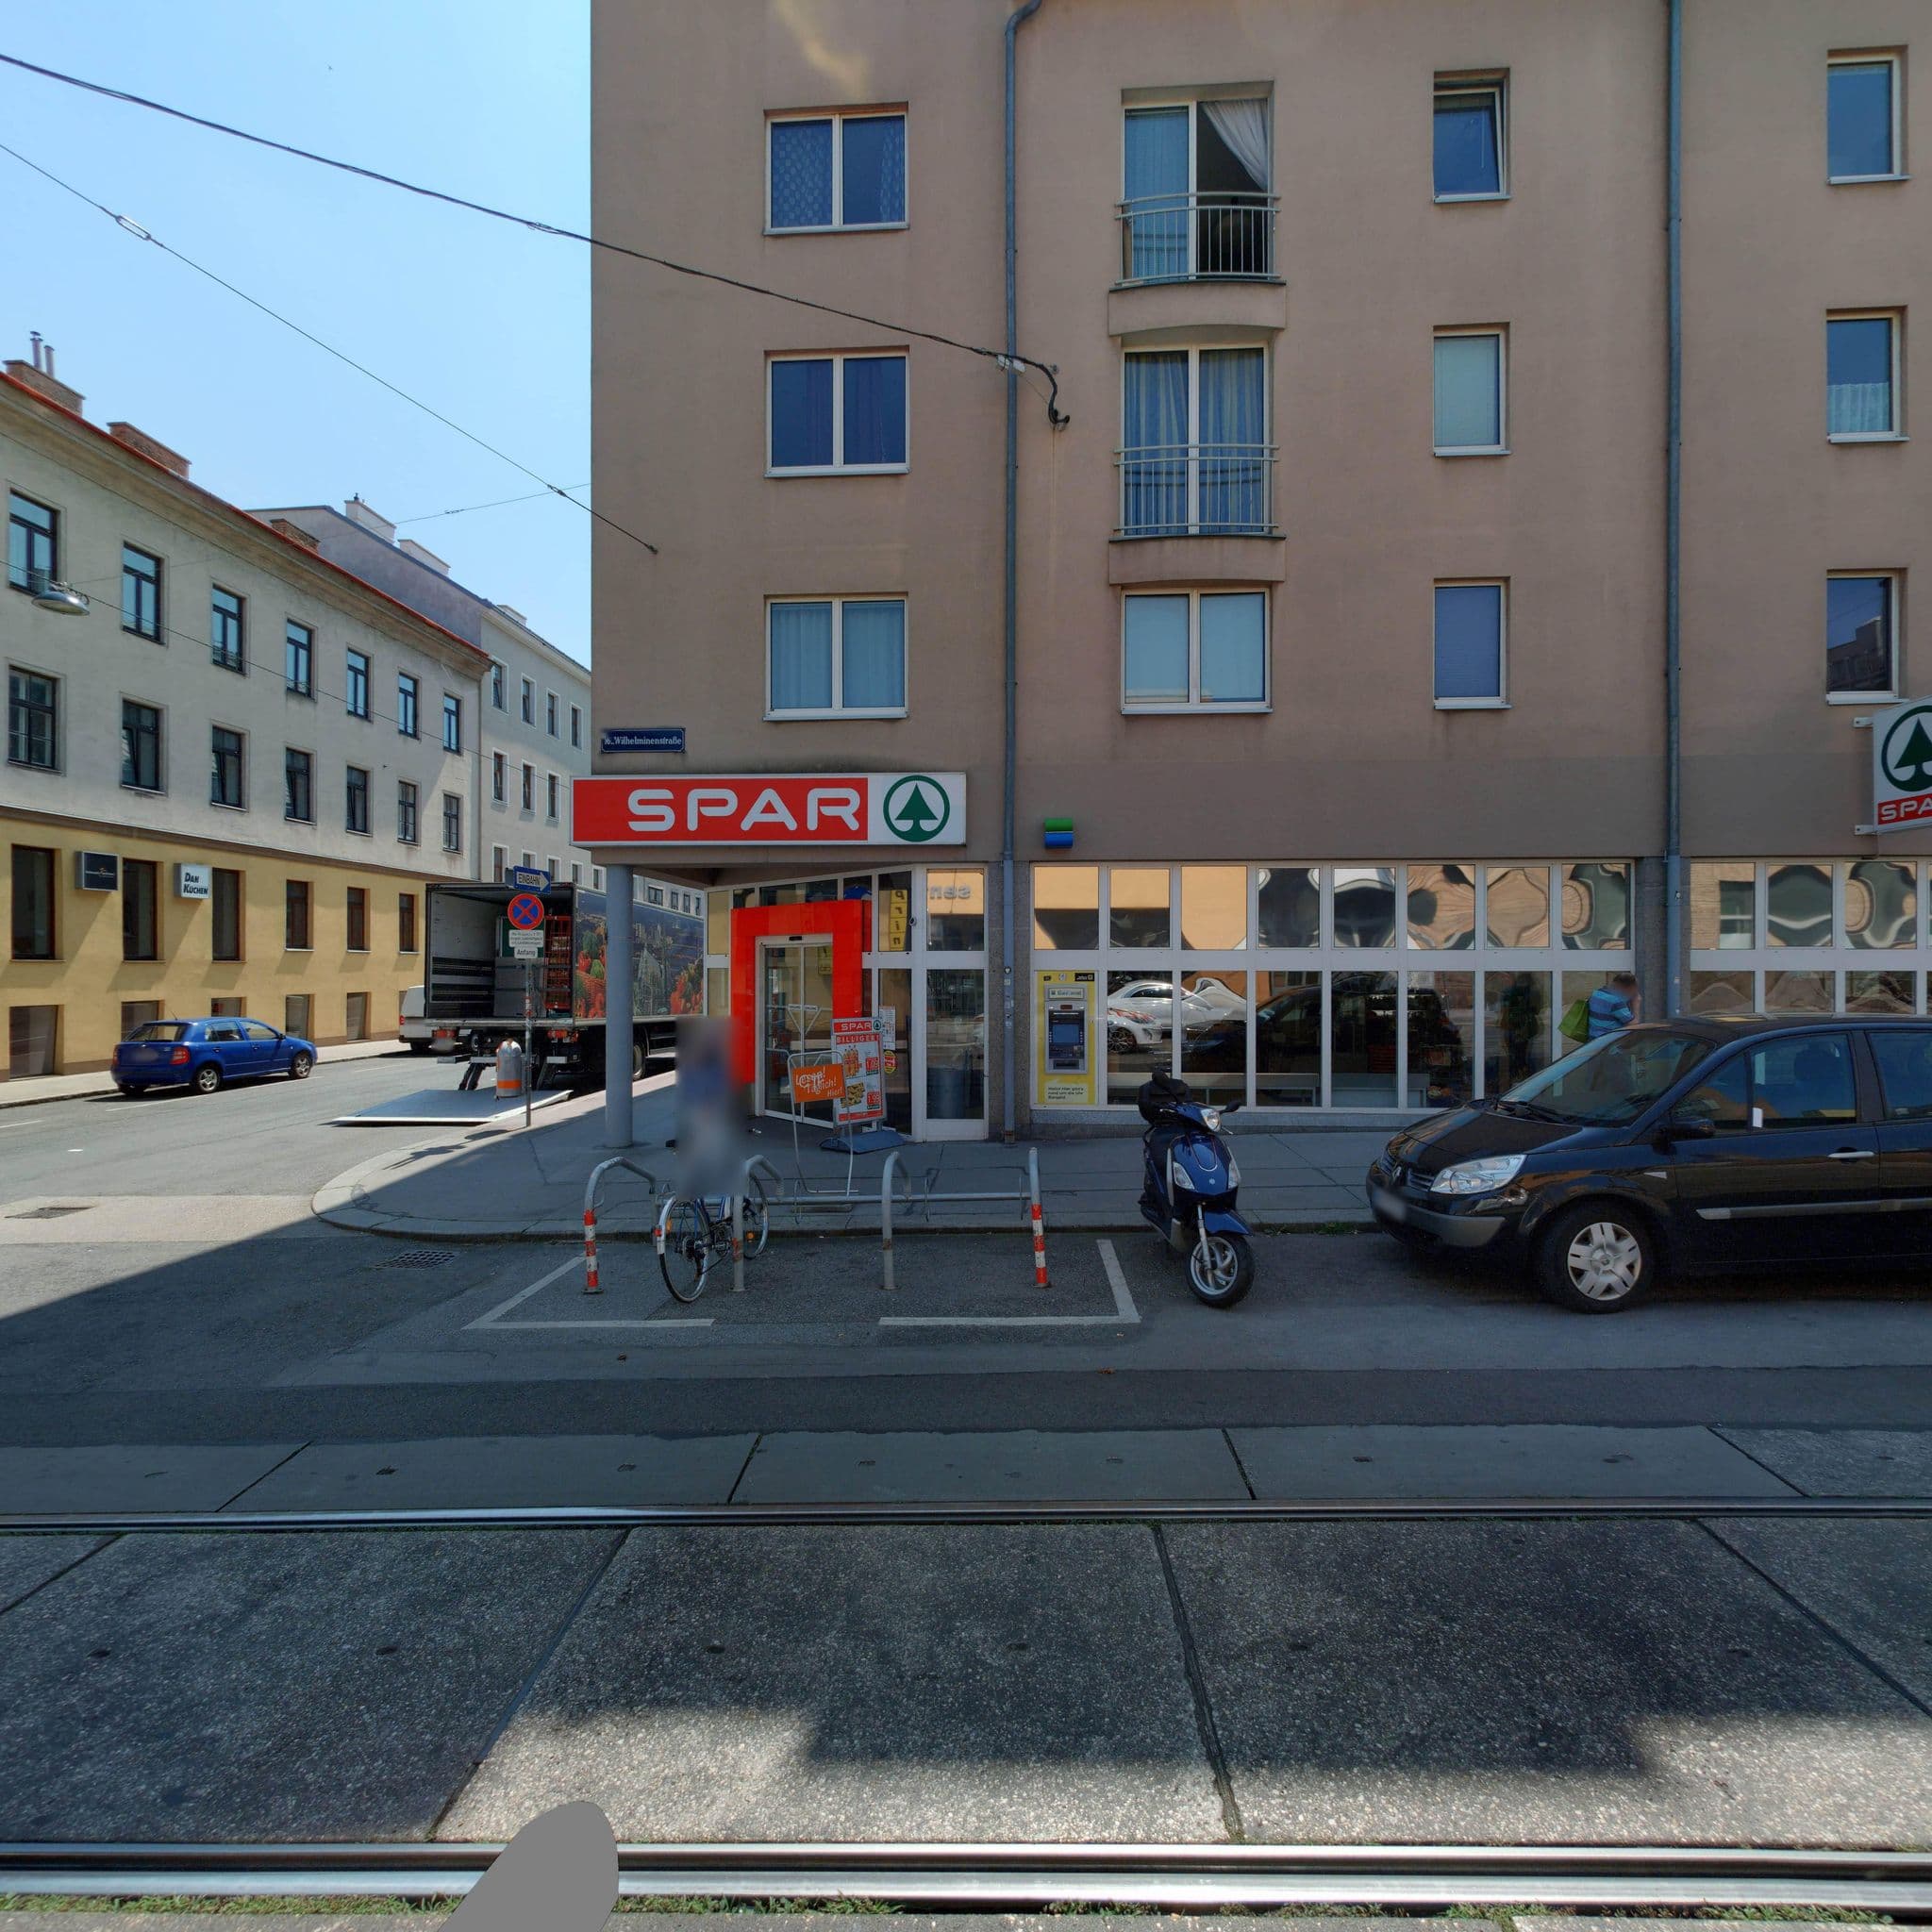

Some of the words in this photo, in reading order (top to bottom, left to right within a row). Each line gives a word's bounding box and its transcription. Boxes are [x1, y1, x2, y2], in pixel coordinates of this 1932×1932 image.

[614, 736, 682, 745] Wilhelminenstraße
[627, 788, 860, 832] SPAR
[184, 873, 199, 883] DAN
[518, 874, 541, 886] EINBAHN
[841, 1022, 873, 1032] SPAR
[836, 1034, 880, 1043] BILLIGER!
